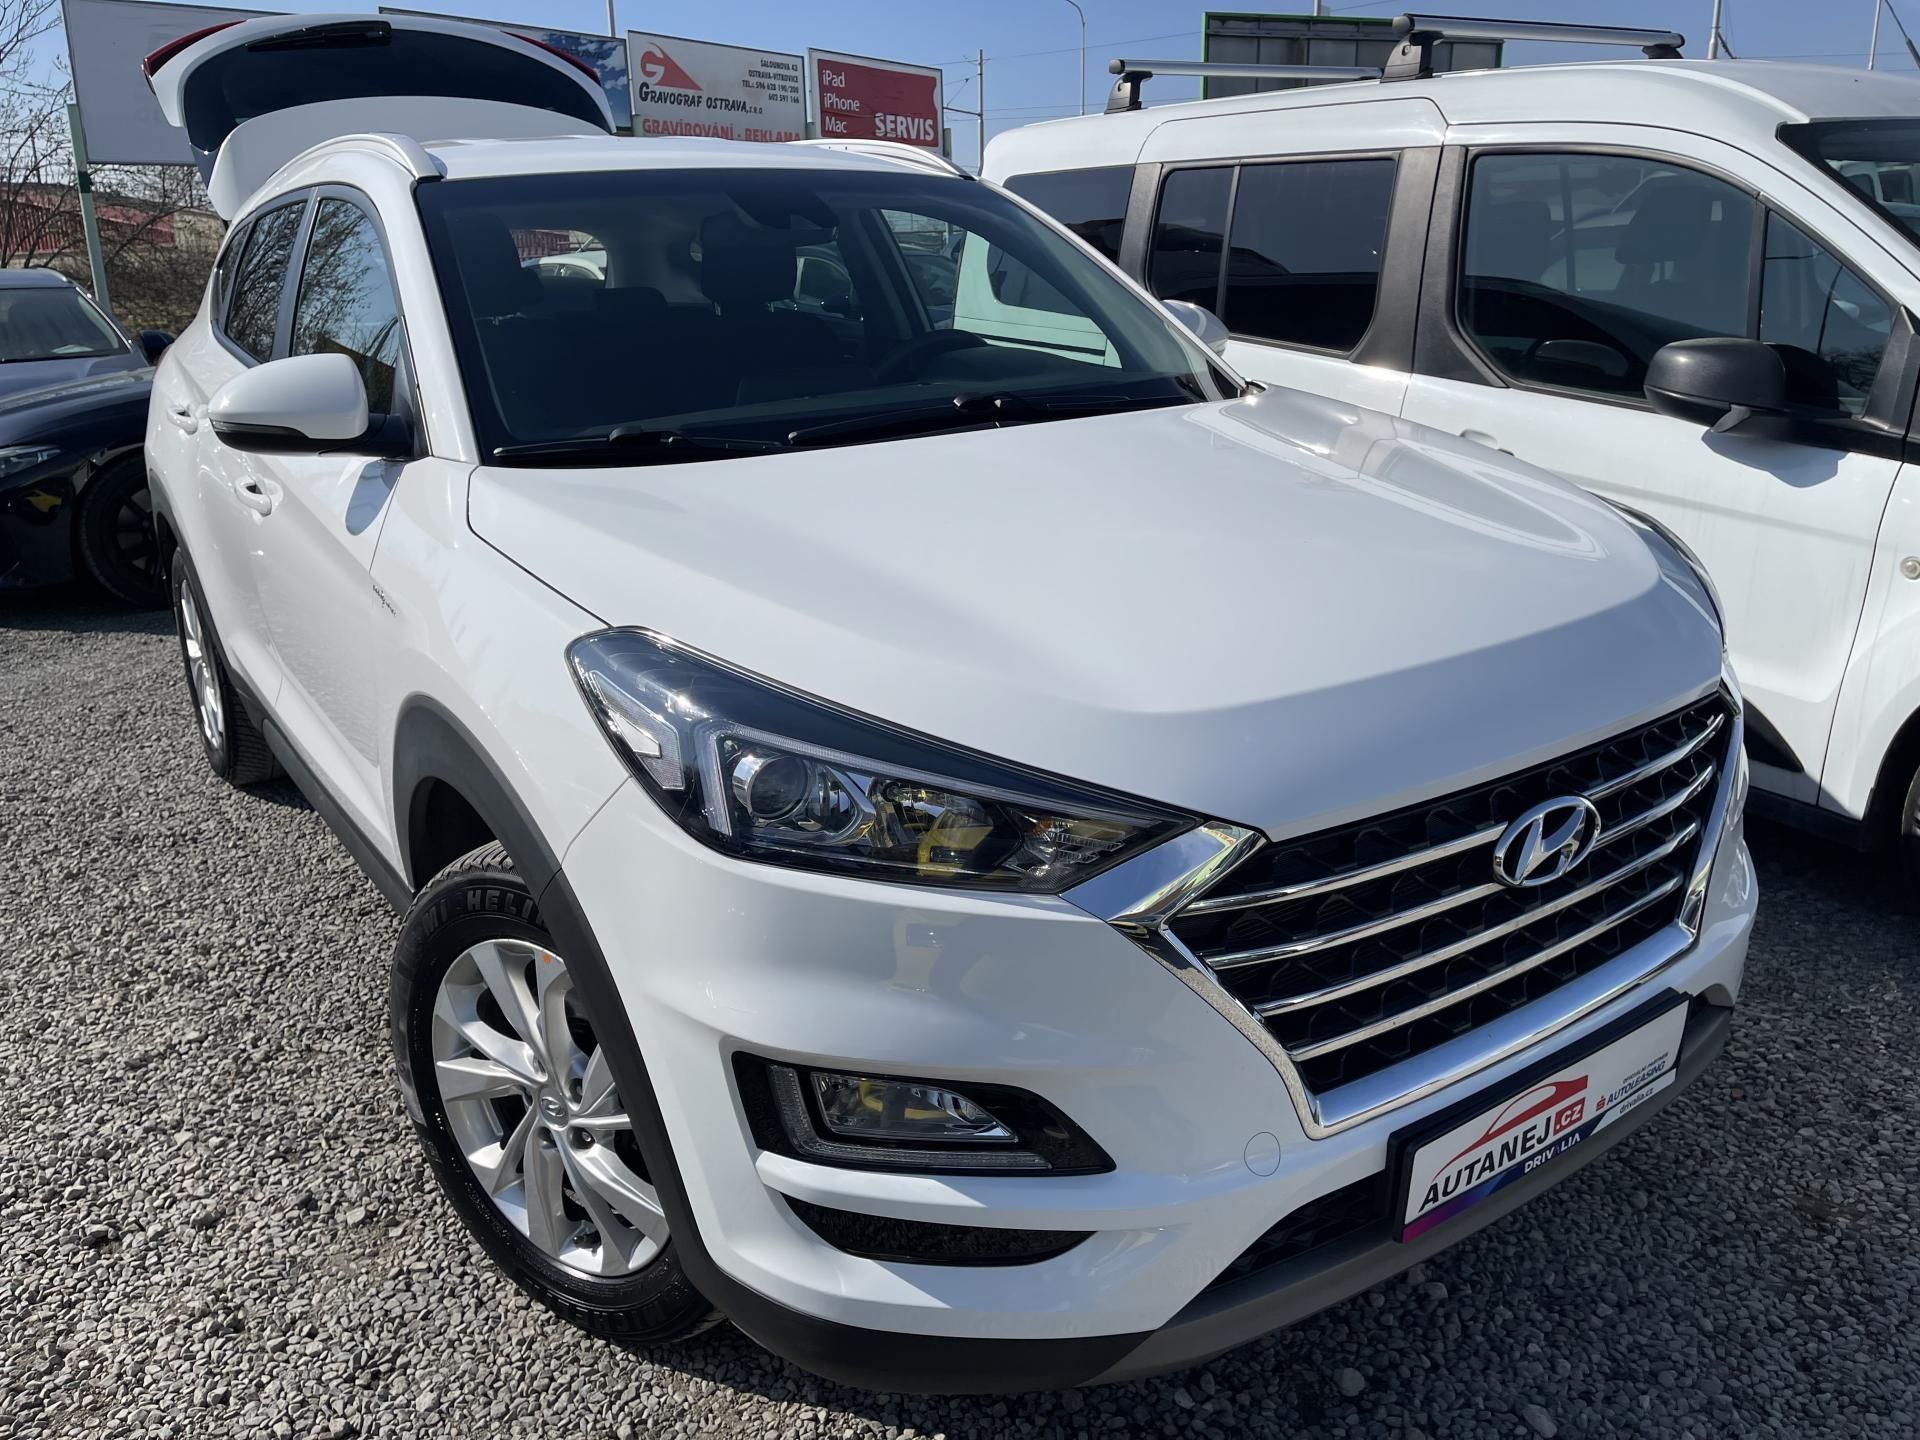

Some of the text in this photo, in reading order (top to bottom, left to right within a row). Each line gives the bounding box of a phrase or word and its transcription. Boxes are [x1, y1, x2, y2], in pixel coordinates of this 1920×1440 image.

[755, 81, 766, 90] 596
[822, 70, 846, 88] iPad
[639, 81, 703, 108] GRAVOGRAF
[779, 94, 789, 103] 591
[790, 95, 800, 104] 166
[824, 93, 860, 111] iPhone
[825, 116, 848, 133] Mac
[874, 112, 935, 141] SERVIS
[744, 127, 801, 142] REKLAMA
[1607, 1060, 1666, 1105] AUTOLEASING
